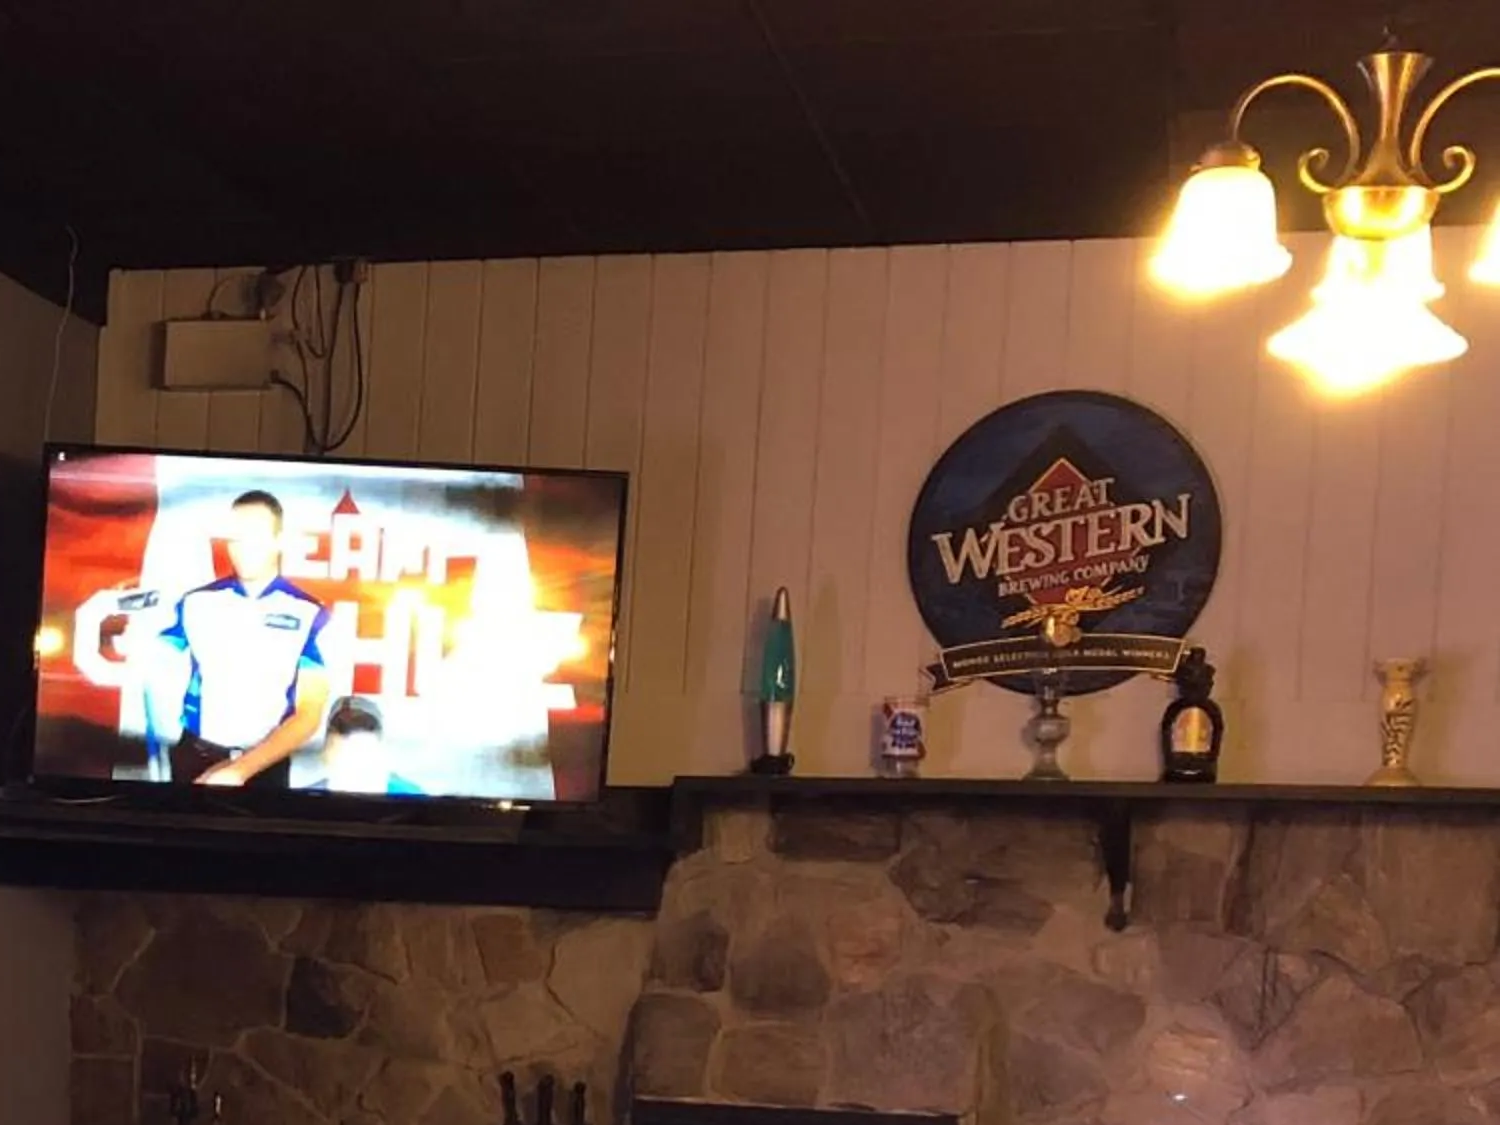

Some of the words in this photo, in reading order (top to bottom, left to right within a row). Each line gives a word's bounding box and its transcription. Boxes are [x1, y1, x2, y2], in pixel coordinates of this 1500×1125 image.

[1008, 477, 1115, 524] GREAT
[931, 493, 1193, 584] WESTERN
[998, 571, 1070, 597] BREWING
[1073, 554, 1150, 581] COMPANY
